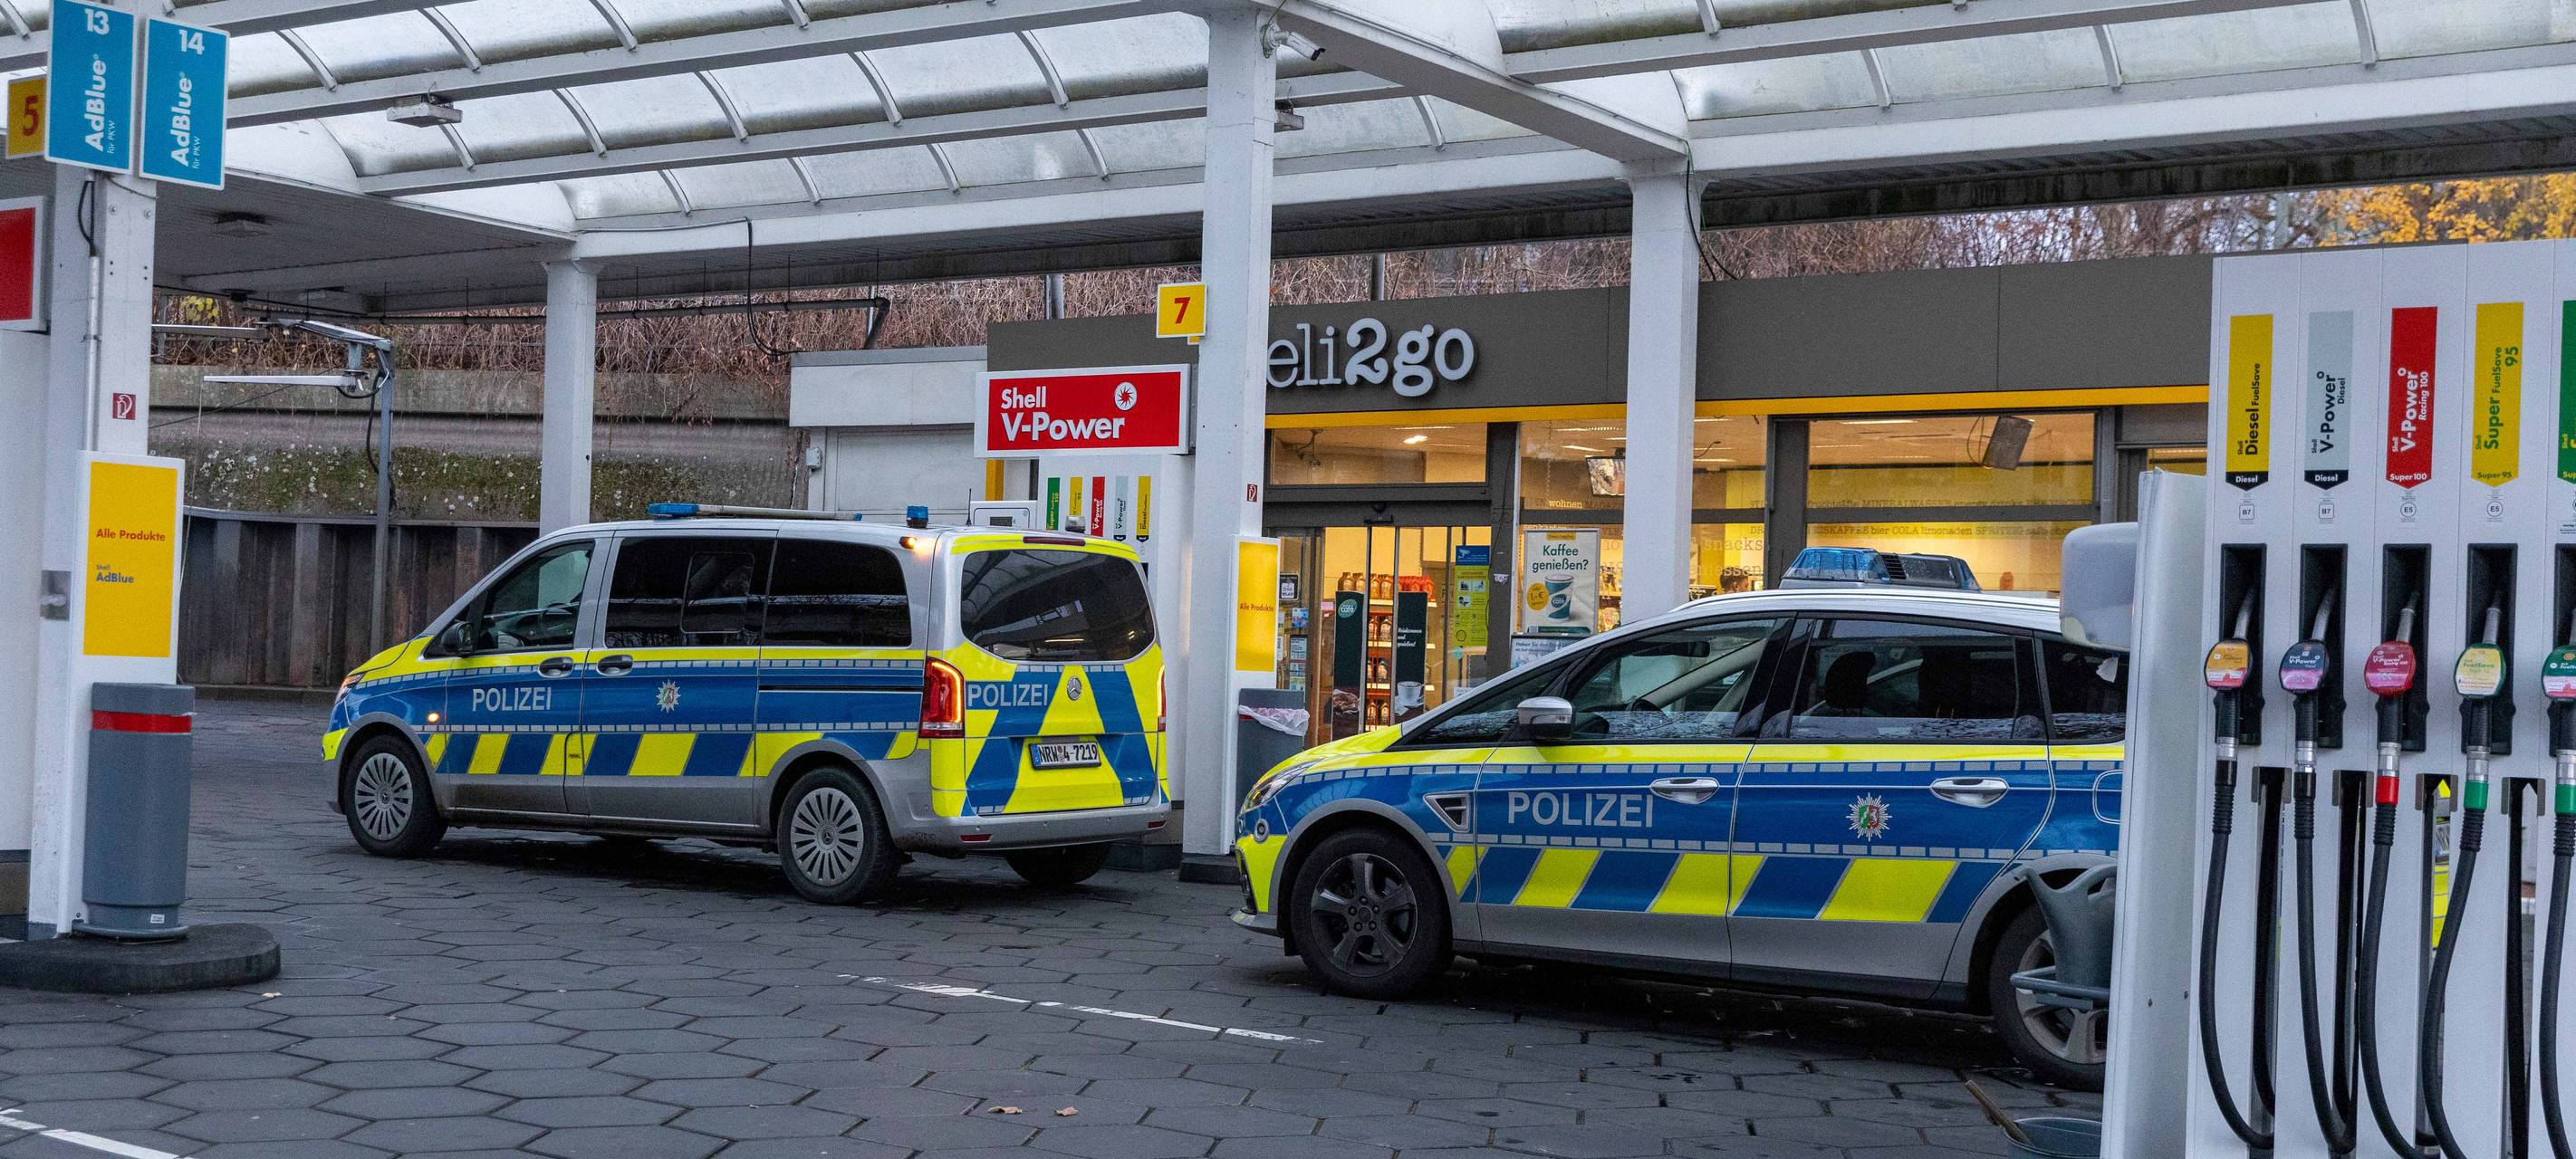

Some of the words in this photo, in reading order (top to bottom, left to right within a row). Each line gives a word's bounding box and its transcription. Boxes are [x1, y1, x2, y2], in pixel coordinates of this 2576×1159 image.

[85, 8, 110, 35] 13
[179, 29, 205, 55] 14
[22, 95, 39, 136] 5
[1174, 296, 1191, 324] 7
[1267, 317, 1475, 398] eli2go
[2504, 346, 2518, 367] 95
[2420, 371, 2428, 388] 100
[2491, 347, 2502, 394] FuelSave
[1001, 386, 1046, 409] Shell
[2418, 391, 2428, 421] Racing
[2245, 408, 2259, 455] Diesel
[2252, 363, 2261, 406] FuelSave
[2319, 375, 2336, 454] V-Power
[2400, 371, 2419, 452] V-Power
[1001, 411, 1126, 441] V-Power
[2484, 397, 2504, 450] Super
[2235, 475, 2258, 484] Diesel
[2314, 474, 2339, 483] Diesel
[2389, 473, 2413, 483] Super
[2477, 472, 2500, 480] Super
[2563, 471, 2576, 480] Sup
[1549, 500, 1583, 508] wohnen
[96, 528, 116, 540] Alle
[119, 530, 166, 541] Produkte
[1871, 526, 1890, 534] bier
[1892, 527, 1918, 535] COLA
[1921, 525, 1972, 535] limonaden
[1543, 544, 1579, 556] Kaffee
[1703, 537, 1763, 551] snacks
[1533, 558, 1589, 573] genießen?
[96, 572, 134, 584] AdBlue
[1251, 604, 1274, 612] Produkte
[472, 687, 552, 712] POLIZEI
[968, 684, 1048, 707] POLIZEI
[1039, 745, 1058, 762] NRW
[1063, 743, 1098, 761] 4-7219
[1507, 791, 1654, 828] POLIZEI
